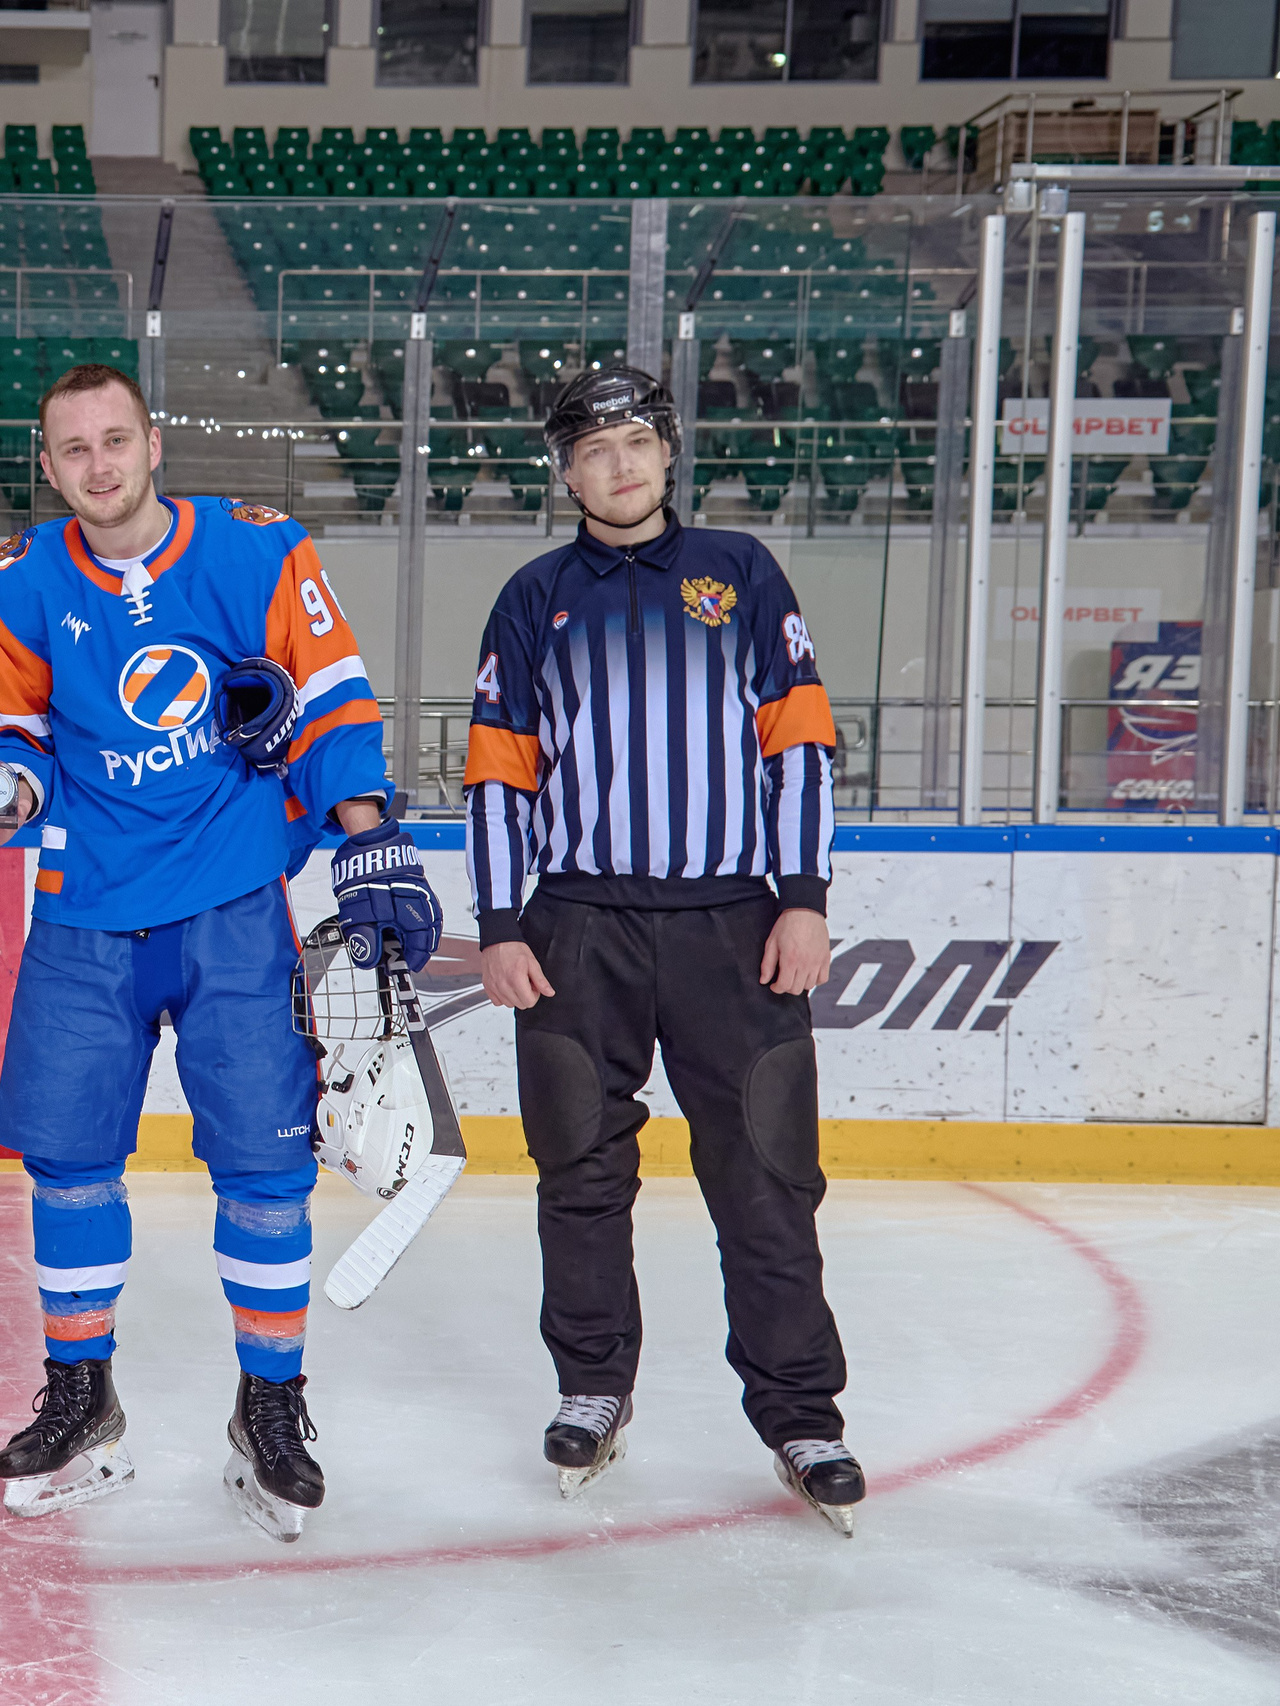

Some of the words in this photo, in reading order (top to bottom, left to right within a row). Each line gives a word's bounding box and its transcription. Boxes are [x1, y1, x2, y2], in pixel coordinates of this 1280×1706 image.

[592, 394, 631, 412] Reebok
[1008, 416, 1165, 436] OLPBET
[1010, 606, 1144, 622] OLPBET
[782, 611, 816, 666] 84
[475, 652, 501, 704] 4
[1111, 778, 1195, 799] СОКО
[808, 937, 1062, 1031] ОЛ!
[277, 1124, 311, 1138] LUTCH
[395, 1122, 415, 1178] CCM
